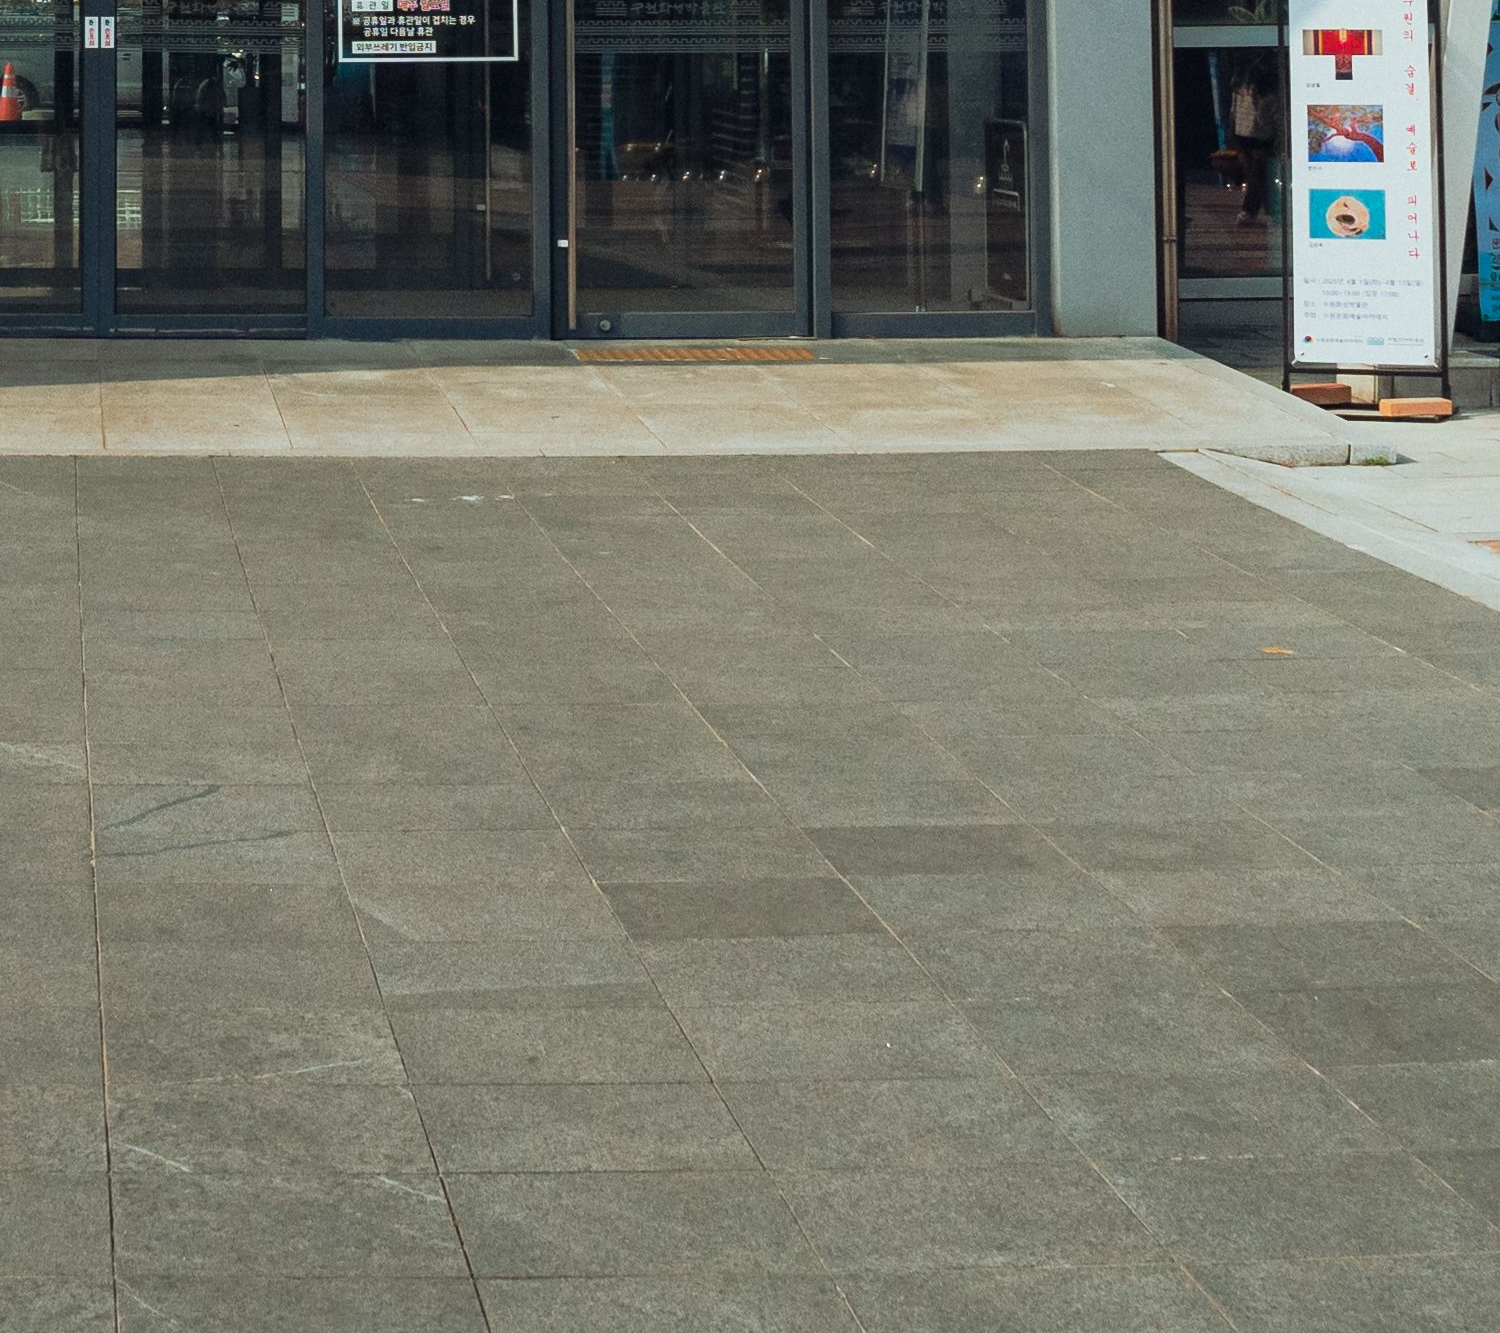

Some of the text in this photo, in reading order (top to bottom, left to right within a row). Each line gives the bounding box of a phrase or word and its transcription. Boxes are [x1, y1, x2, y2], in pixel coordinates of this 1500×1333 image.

[362, 16, 395, 25] 공휴일과
[398, 16, 430, 25] 휴관일이
[432, 15, 457, 25] 겹치는
[459, 15, 476, 25] 경우
[363, 27, 434, 37] 공휴일 다음날 휴관
[356, 43, 433, 52] 외부쓰레기 반입금지
